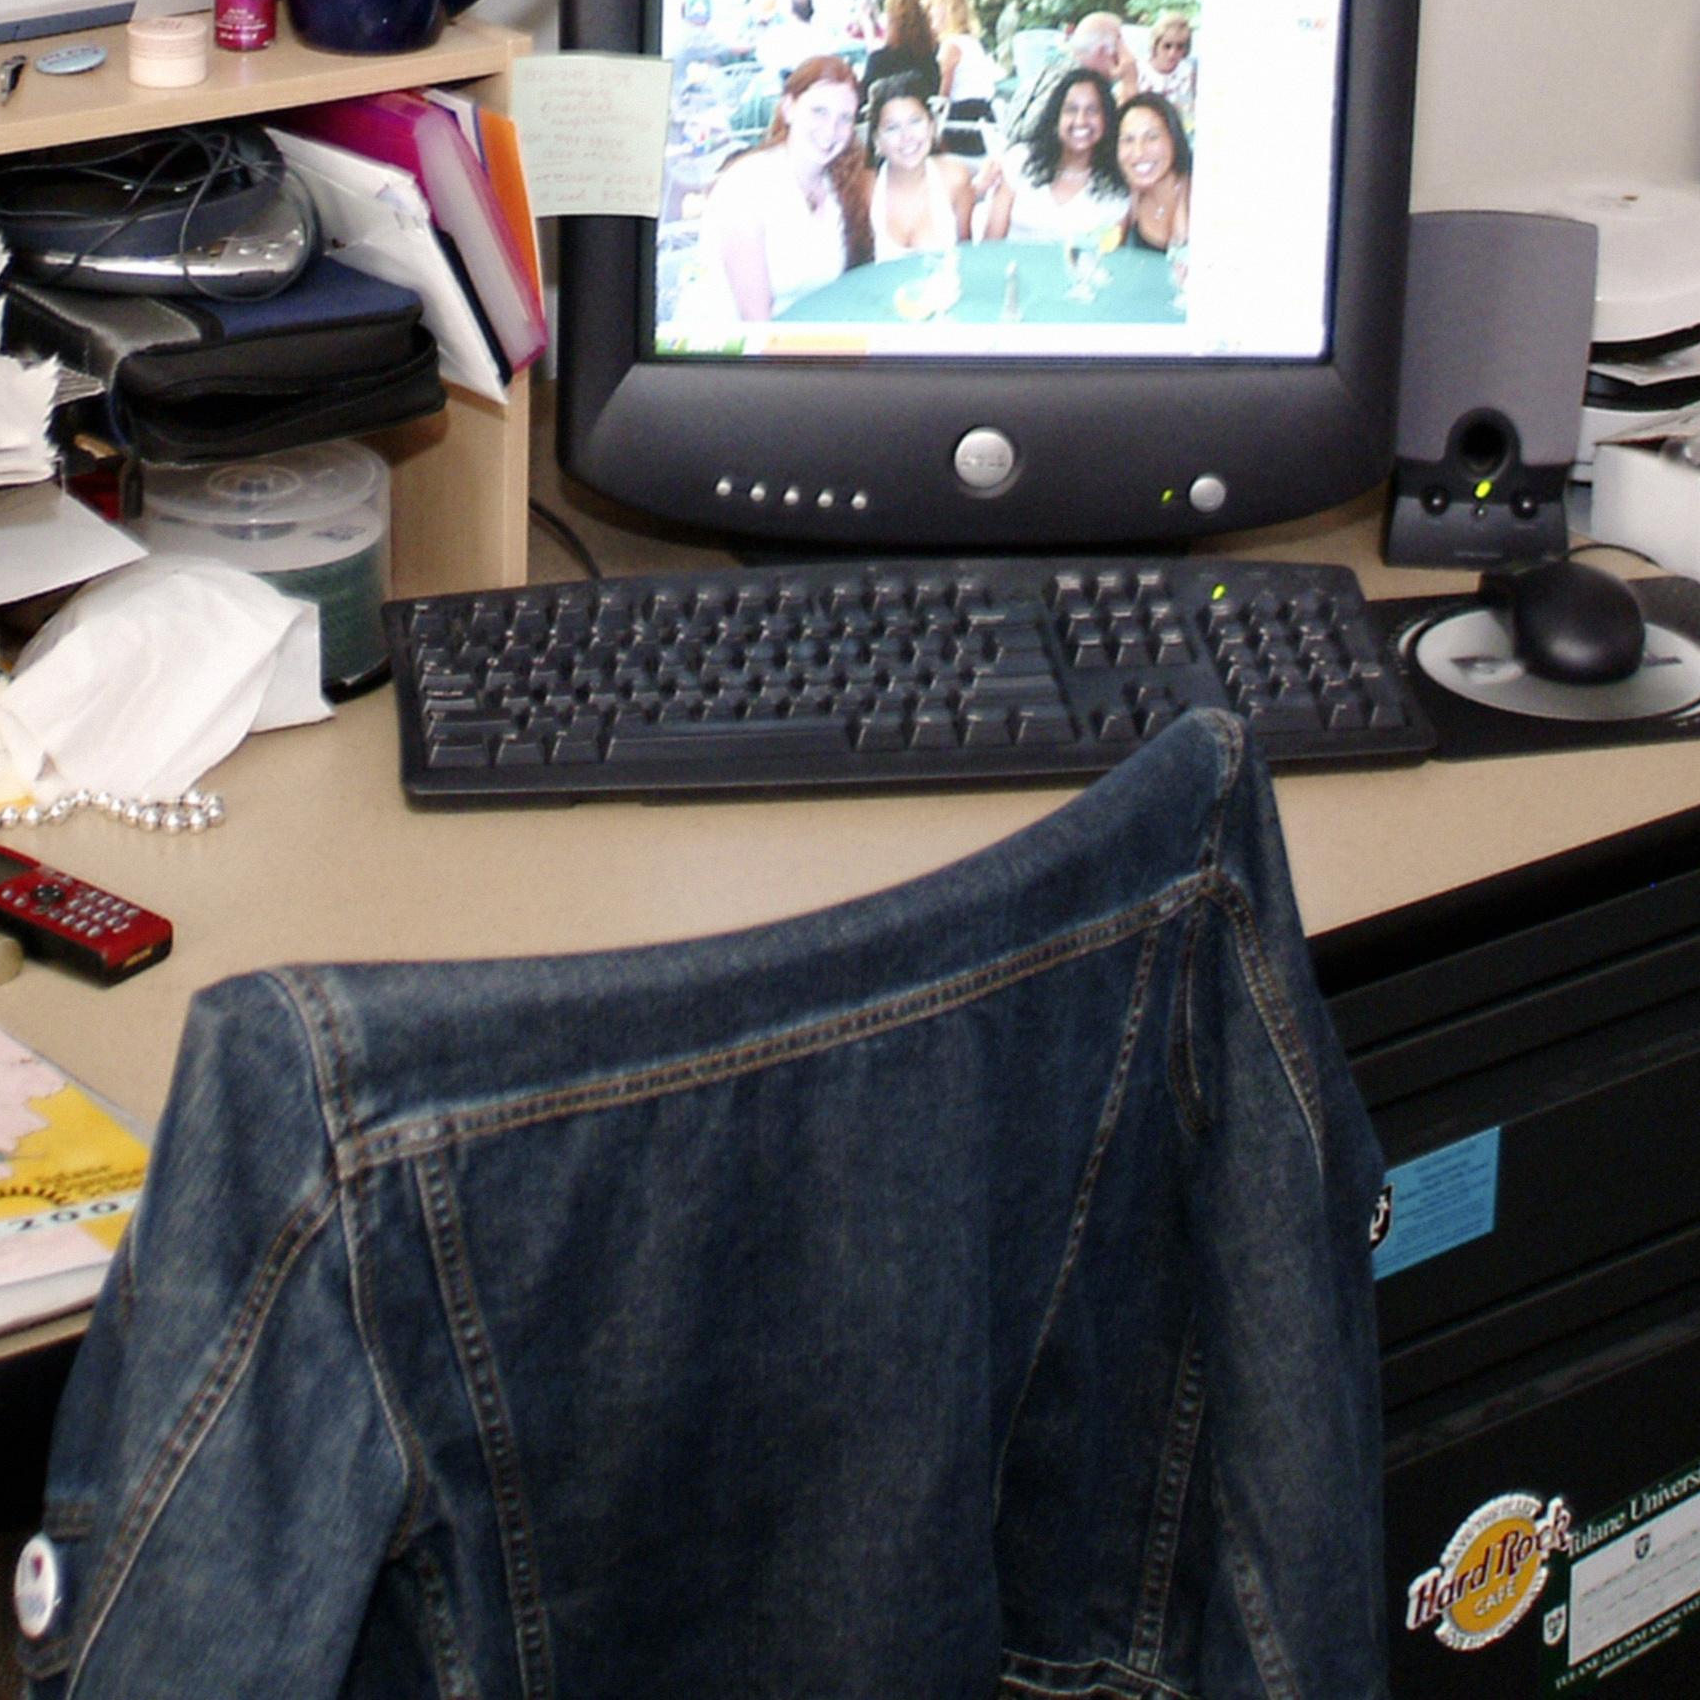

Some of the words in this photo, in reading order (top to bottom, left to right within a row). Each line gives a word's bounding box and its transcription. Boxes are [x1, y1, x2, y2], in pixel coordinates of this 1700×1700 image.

[1568, 1511, 1627, 1558] Tulane
[1410, 1543, 1494, 1626] Hard
[1494, 1503, 1571, 1578] Rock
[1473, 1578, 1517, 1617] CAFE
[1602, 1628, 1650, 1663] ALUMNI
